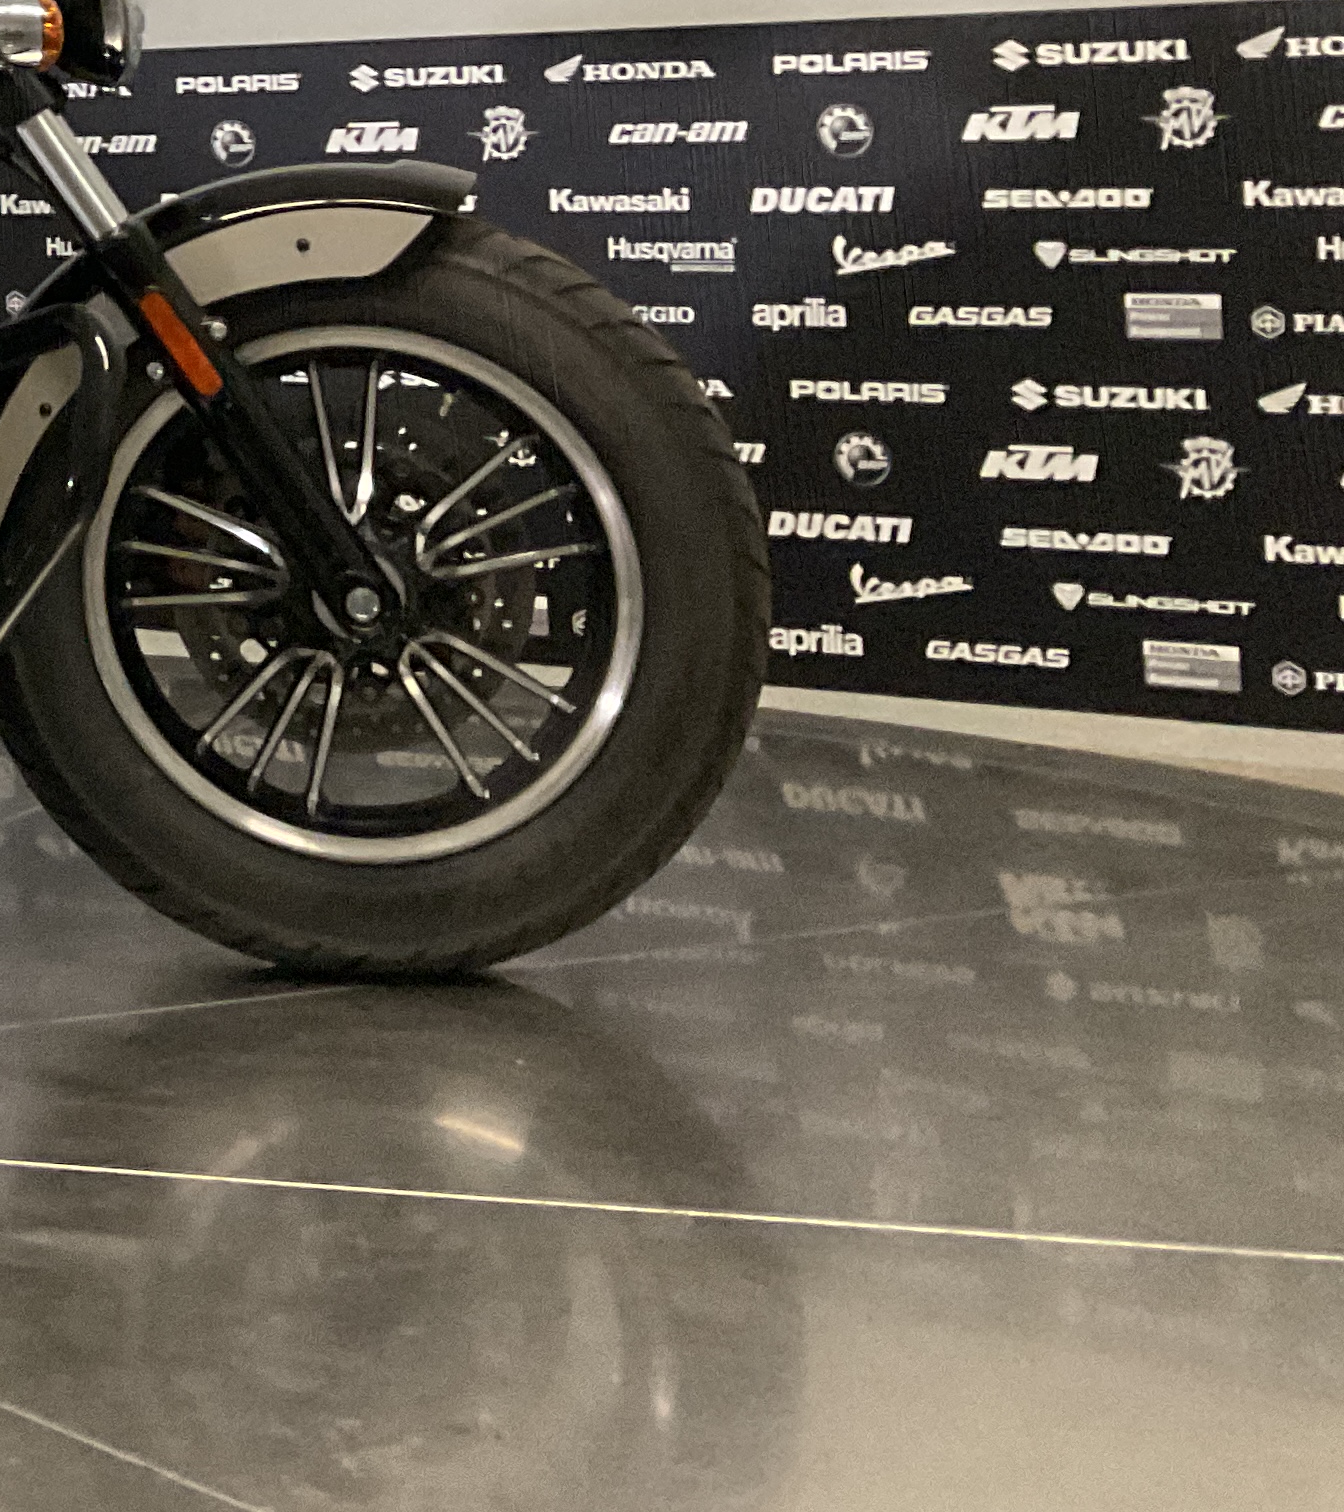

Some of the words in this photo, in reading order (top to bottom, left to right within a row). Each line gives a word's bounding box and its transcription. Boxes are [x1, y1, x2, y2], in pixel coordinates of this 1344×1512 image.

[773, 51, 930, 74] POLARIS
[1036, 39, 1190, 65] SUZUKI
[176, 74, 301, 93] POLARIS
[384, 64, 505, 87] SUZUKI
[583, 61, 716, 81] HONDA
[608, 121, 748, 143] can-am
[962, 105, 1080, 141] KTM
[326, 122, 418, 153] KTM
[549, 188, 690, 212] Kawasaki
[750, 187, 895, 213] DUCATI
[752, 298, 846, 331] aprilia
[908, 306, 1052, 326] GASGAS
[790, 380, 946, 403] POLARIS
[1054, 385, 1209, 410] SUZUKI
[980, 445, 1098, 481] KTM
[768, 511, 912, 543] DUCATI
[769, 625, 863, 656] aprilia
[926, 640, 1069, 668] GASGAS
